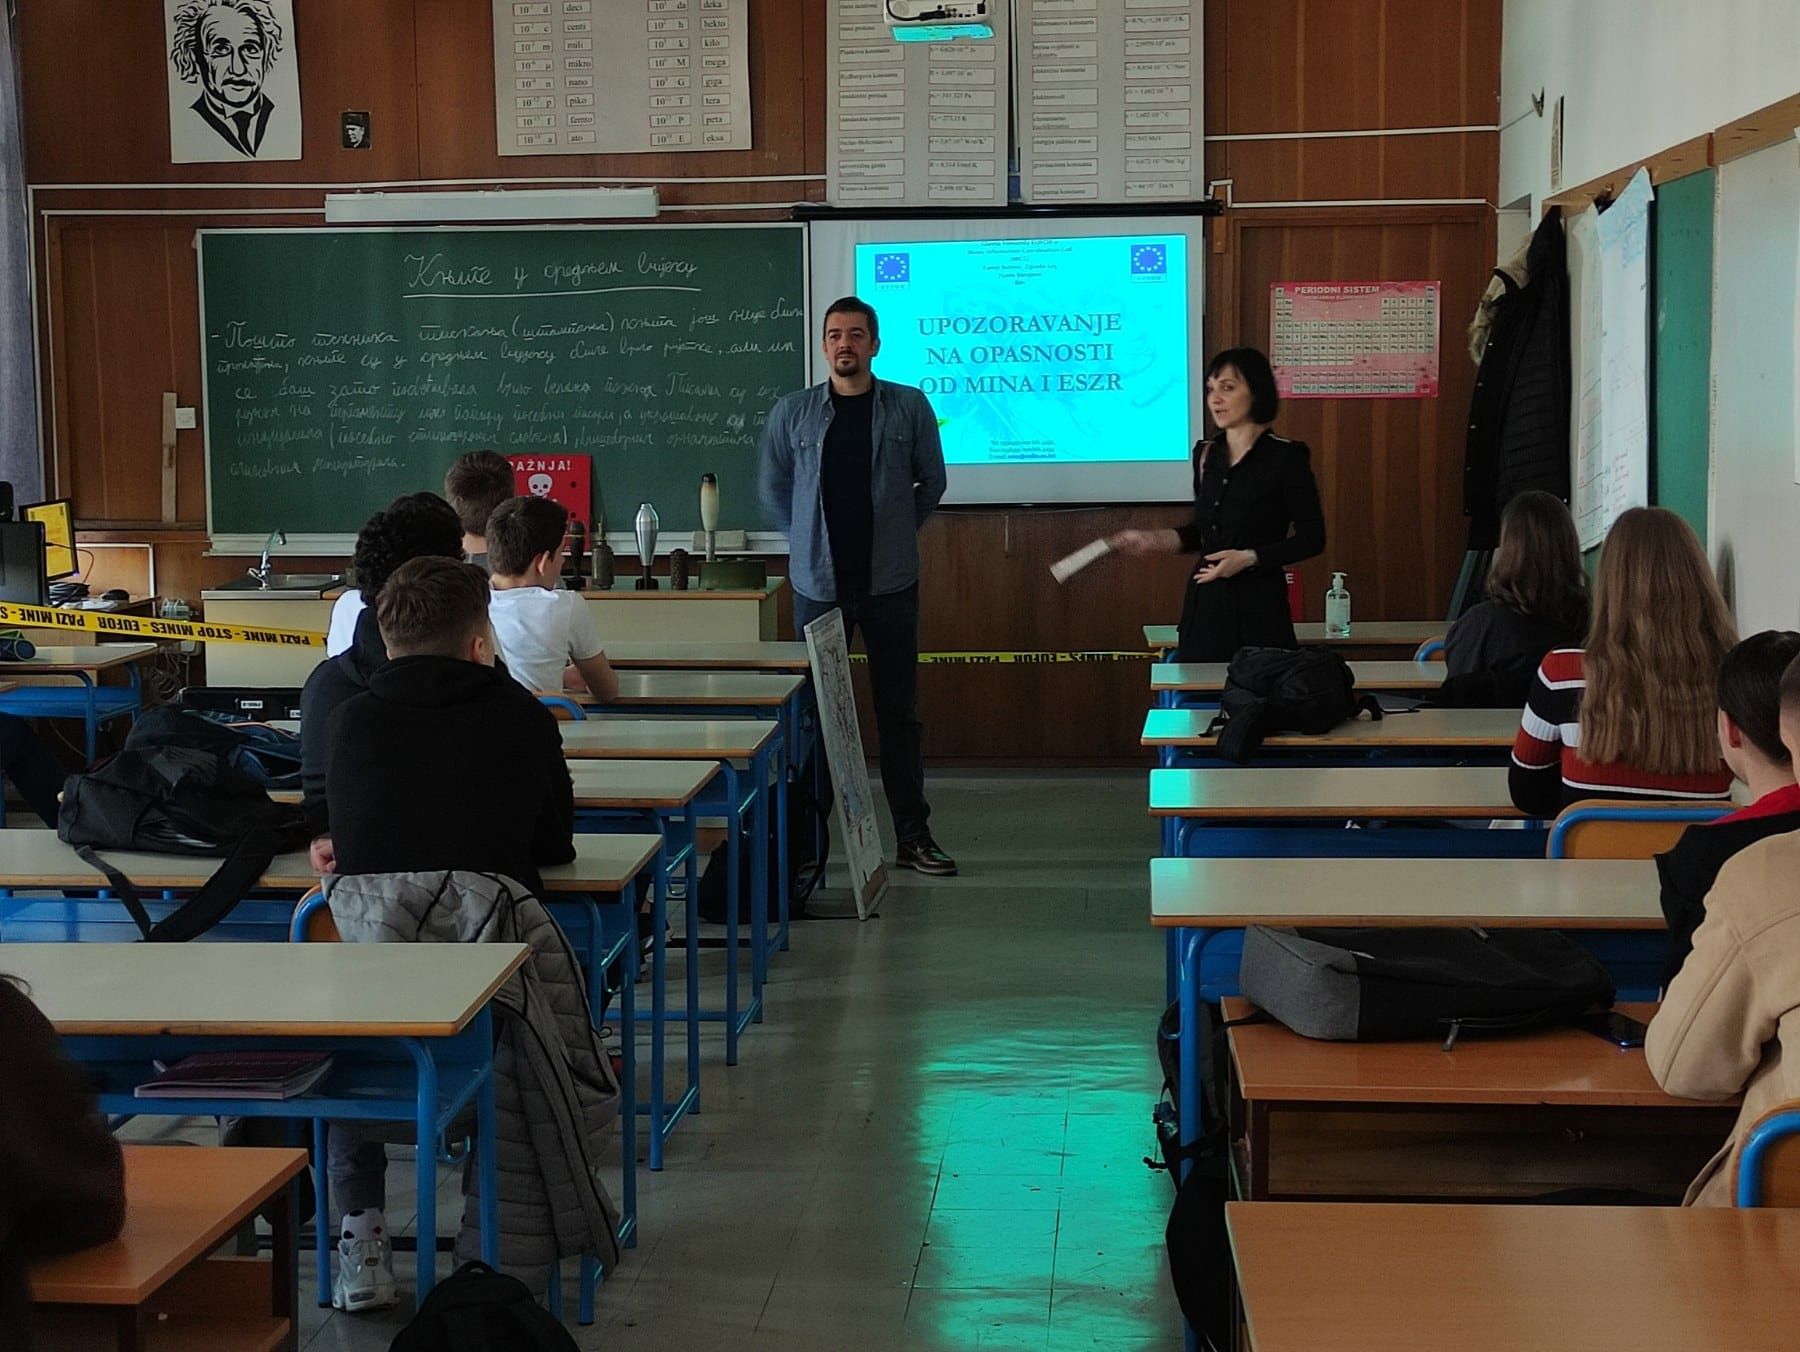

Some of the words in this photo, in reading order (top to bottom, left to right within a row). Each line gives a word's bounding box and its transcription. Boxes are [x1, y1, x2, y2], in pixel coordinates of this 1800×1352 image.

[1295, 286, 1341, 294] PERIODNI
[1343, 285, 1380, 293] SISTEM
[917, 312, 1122, 336] UPOZORAVANJE
[926, 347, 962, 366] NA
[969, 343, 1114, 366] OPASNOSTI
[919, 376, 957, 395] OD
[964, 375, 1032, 394] MINA
[1040, 374, 1050, 392] I
[1057, 373, 1123, 393] ESZR
[508, 459, 572, 472] AŽNJA!
[19, 608, 53, 624] MINE
[56, 612, 85, 627] PAZI
[97, 616, 140, 632] EUFOR
[152, 621, 194, 637] MINES
[197, 625, 233, 639] STOP
[244, 630, 277, 644] MINE
[280, 632, 311, 646] PAZI
